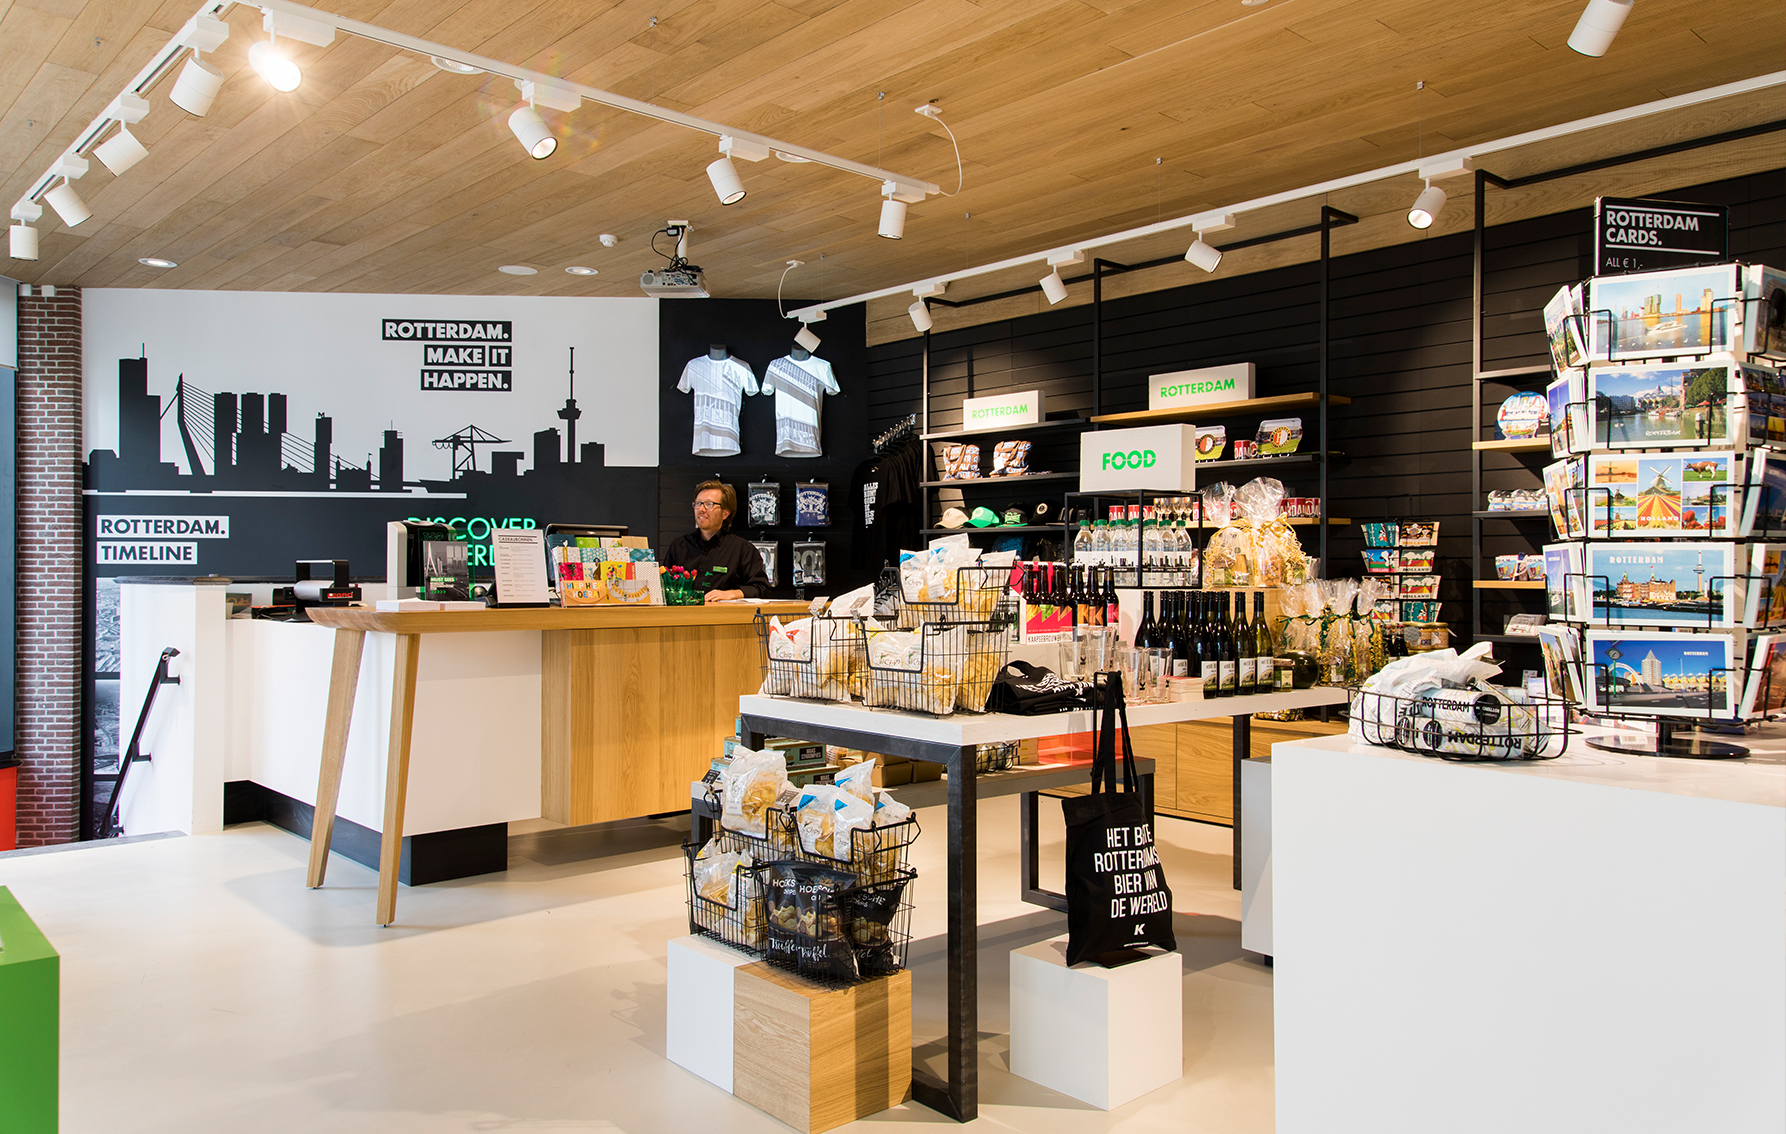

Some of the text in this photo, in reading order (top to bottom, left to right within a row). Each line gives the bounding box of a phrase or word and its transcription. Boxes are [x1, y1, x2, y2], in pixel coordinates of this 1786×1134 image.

[1606, 210, 1700, 231] ROTTERDAM
[1605, 227, 1663, 246] CARDS.
[1605, 257, 1620, 268] ALL
[1623, 257, 1630, 268] €
[385, 321, 509, 340] ROTTERDAM.
[427, 347, 509, 364] MAKE IT
[423, 372, 509, 389] HAPPEN.
[1160, 377, 1236, 398] ROTTERDAM
[971, 403, 1029, 420] ROTTERDAM
[1101, 449, 1157, 471] FOOD
[100, 518, 226, 535] ROTTERDAM.
[100, 545, 193, 561] TIMELINE
[1609, 555, 1664, 564] ROTTERDAM
[566, 582, 603, 590] HIEP HIEP
[572, 590, 600, 598] HOERA!
[1422, 696, 1471, 713] ROTTERDAM
[1106, 827, 1130, 848] HET
[1113, 869, 1158, 895] BIER VAN
[1110, 890, 1168, 919] DE WERELD
[1133, 923, 1146, 936] K
